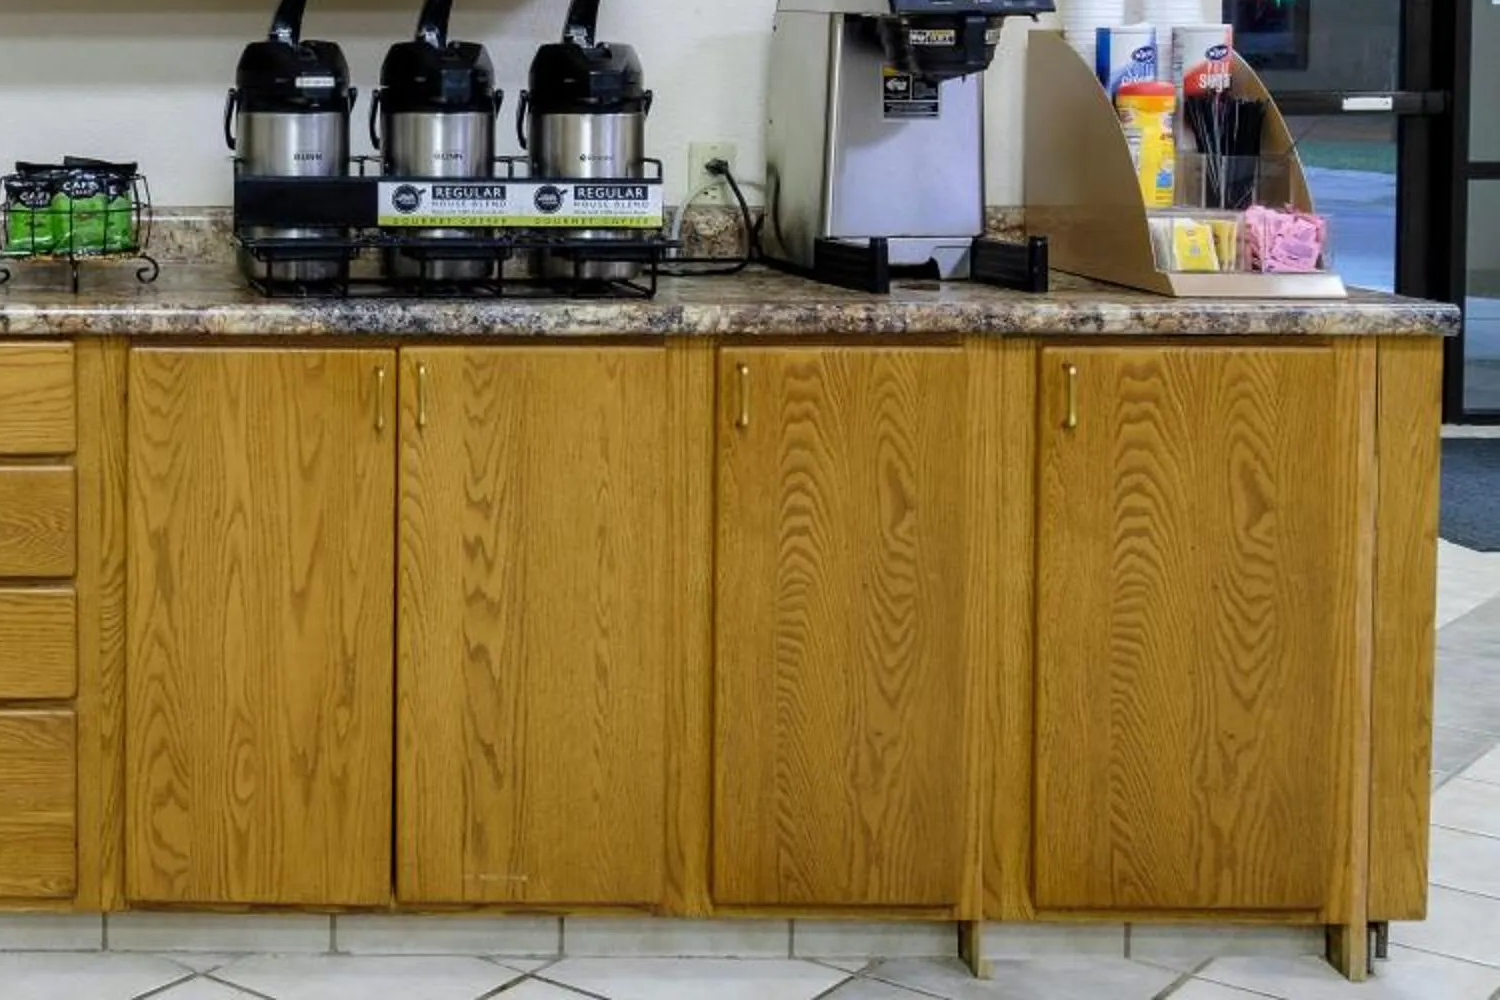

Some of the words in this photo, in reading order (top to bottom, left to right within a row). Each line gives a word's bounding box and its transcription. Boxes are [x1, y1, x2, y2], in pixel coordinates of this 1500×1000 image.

[435, 187, 502, 199] REGULAR
[577, 187, 644, 199] REGULAR
[573, 201, 609, 209] HOUSE
